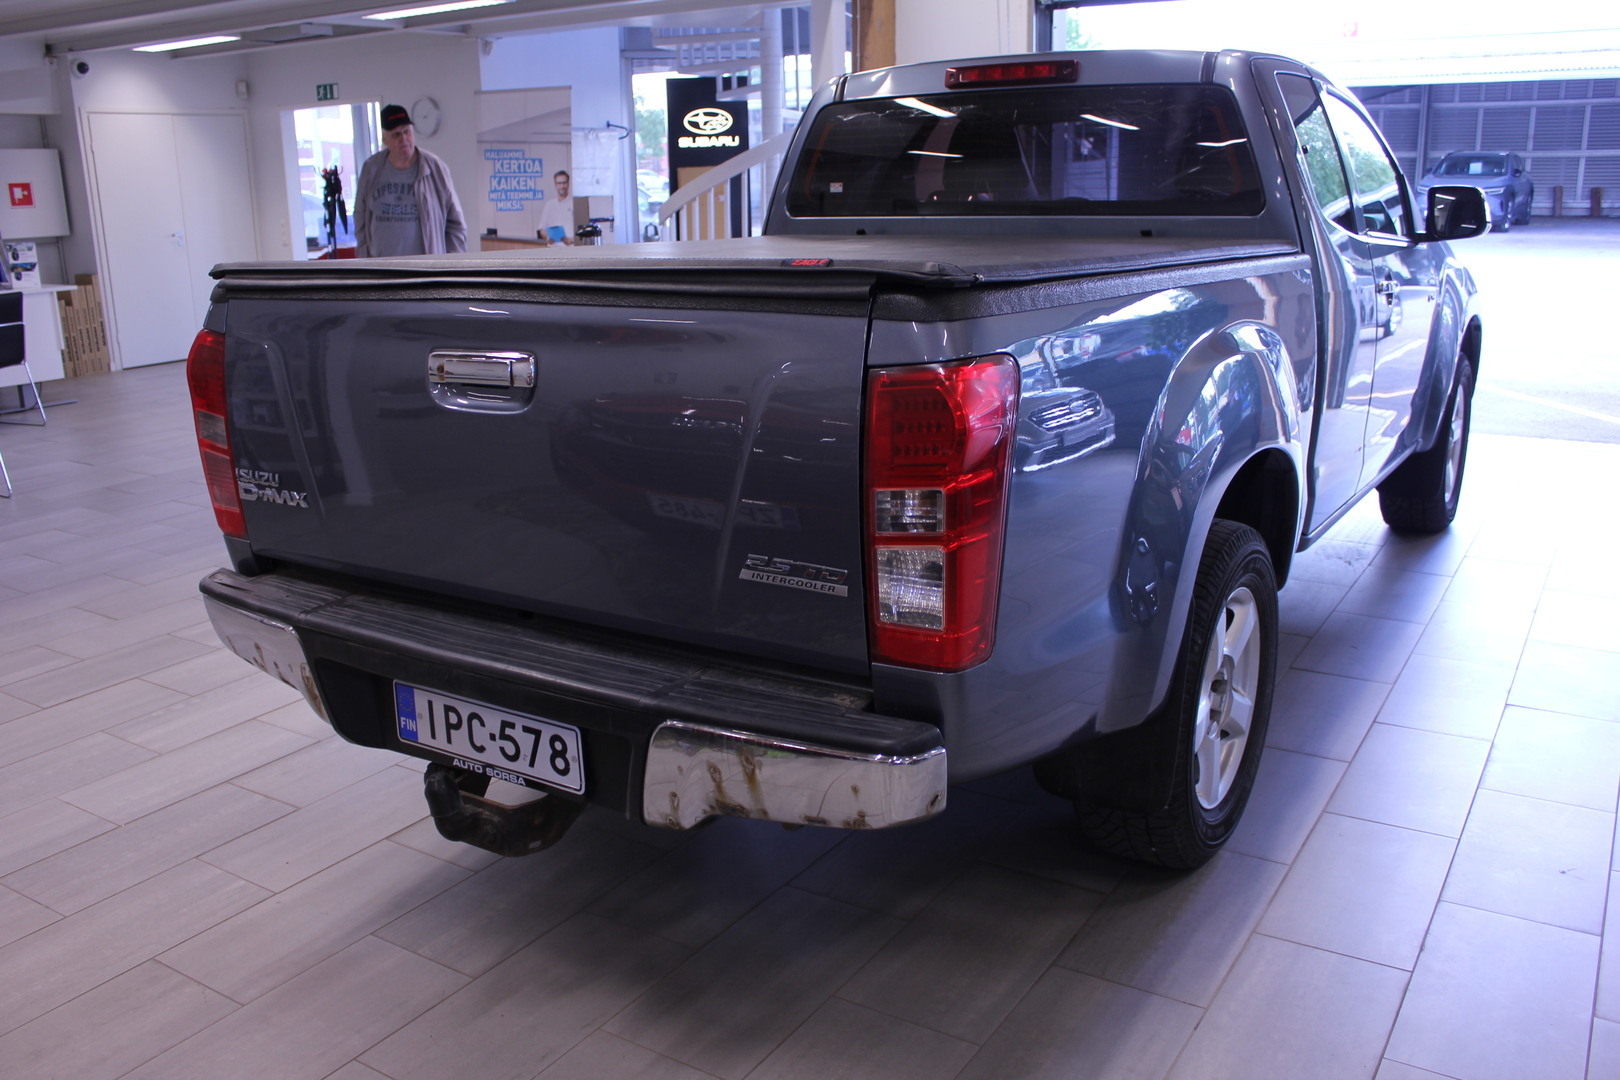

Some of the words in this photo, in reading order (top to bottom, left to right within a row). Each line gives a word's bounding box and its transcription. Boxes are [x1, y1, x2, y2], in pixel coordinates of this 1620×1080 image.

[678, 135, 740, 148] SUBARU
[495, 160, 542, 173] KERTOA
[491, 177, 535, 190] KAIKEN
[489, 190, 506, 200] MITÄ
[236, 468, 279, 487] ISUZU
[238, 481, 309, 508] D-MAX
[751, 572, 837, 593] INTERCOOLER
[400, 717, 416, 732] FIN
[427, 699, 571, 777] IPC-578
[452, 758, 483, 775] AUTO
[486, 767, 526, 786] SORSA
